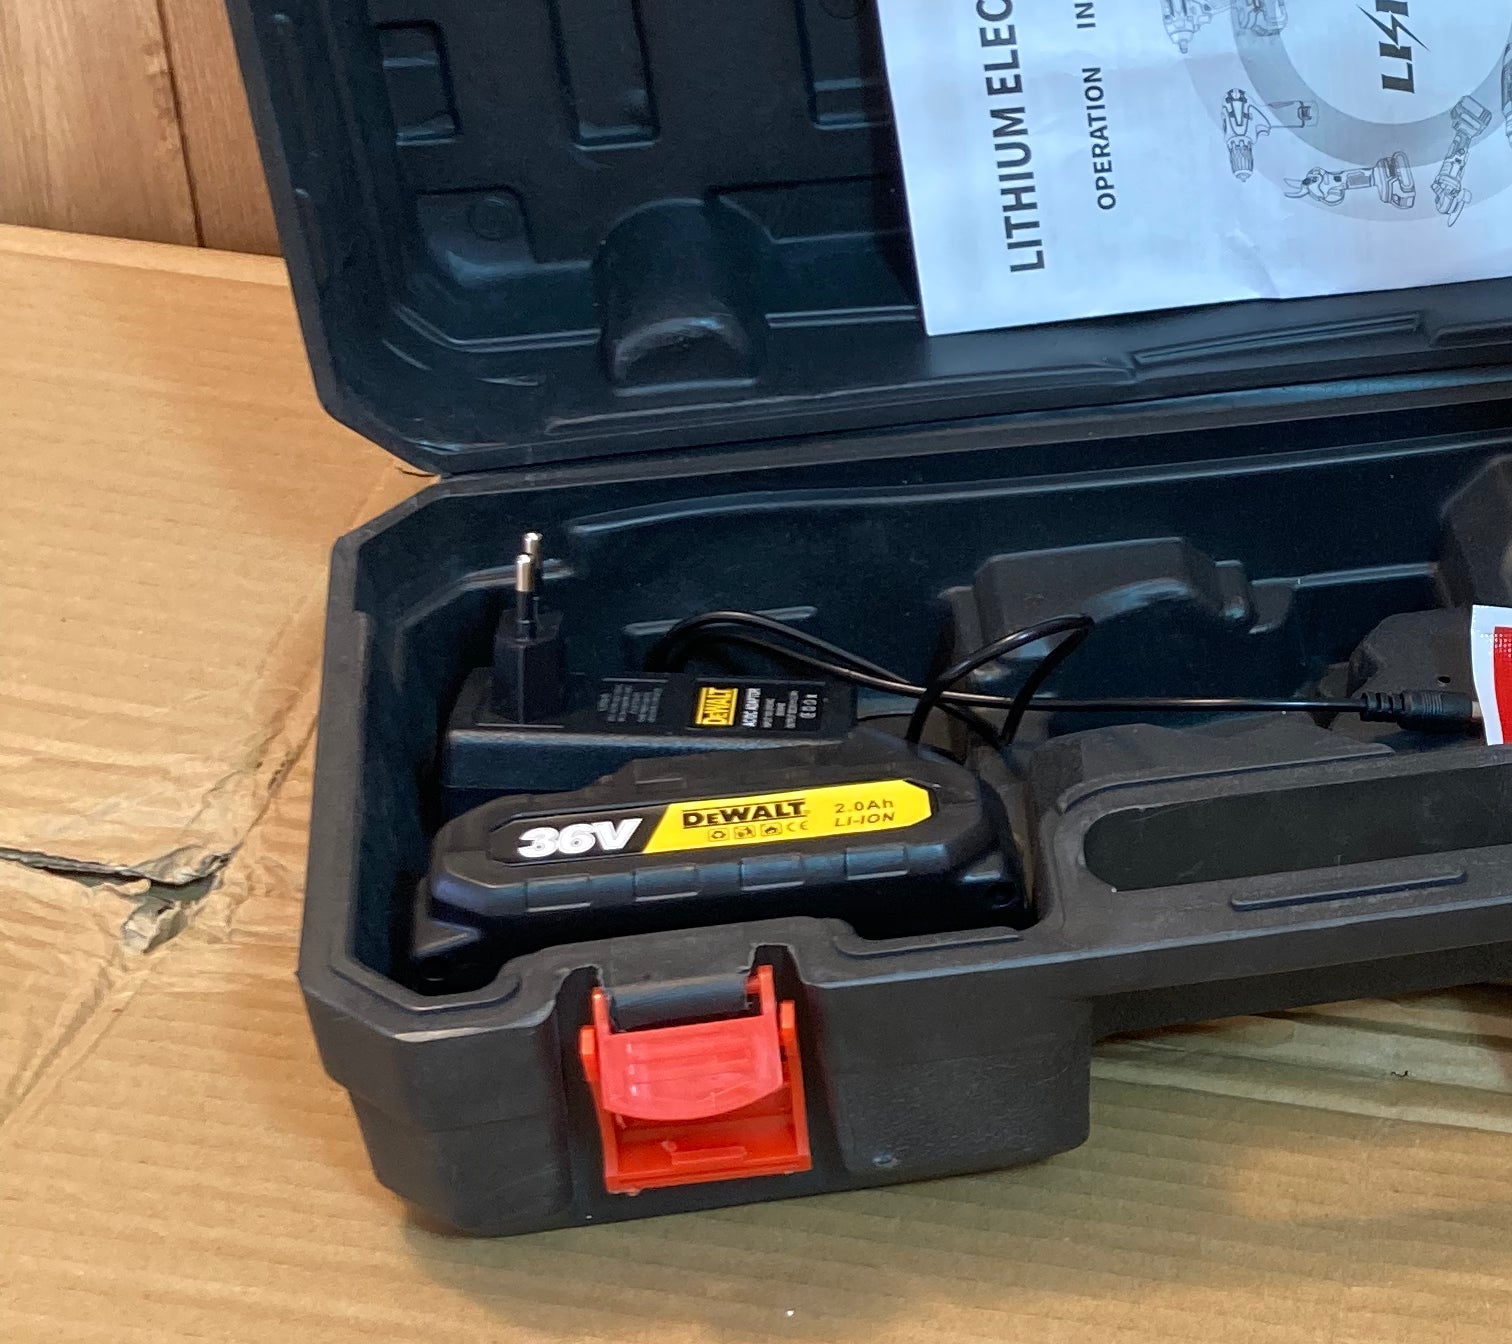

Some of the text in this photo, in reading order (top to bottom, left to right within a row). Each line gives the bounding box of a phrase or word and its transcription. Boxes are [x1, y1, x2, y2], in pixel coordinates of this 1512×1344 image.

[1081, 66, 1117, 211] OPERATION
[992, 106, 1046, 274] LITHIUM
[681, 799, 807, 829] DeWALT
[833, 798, 895, 815] 2.0Ah
[833, 812, 896, 828] LI-ION
[516, 817, 644, 859] 36V
